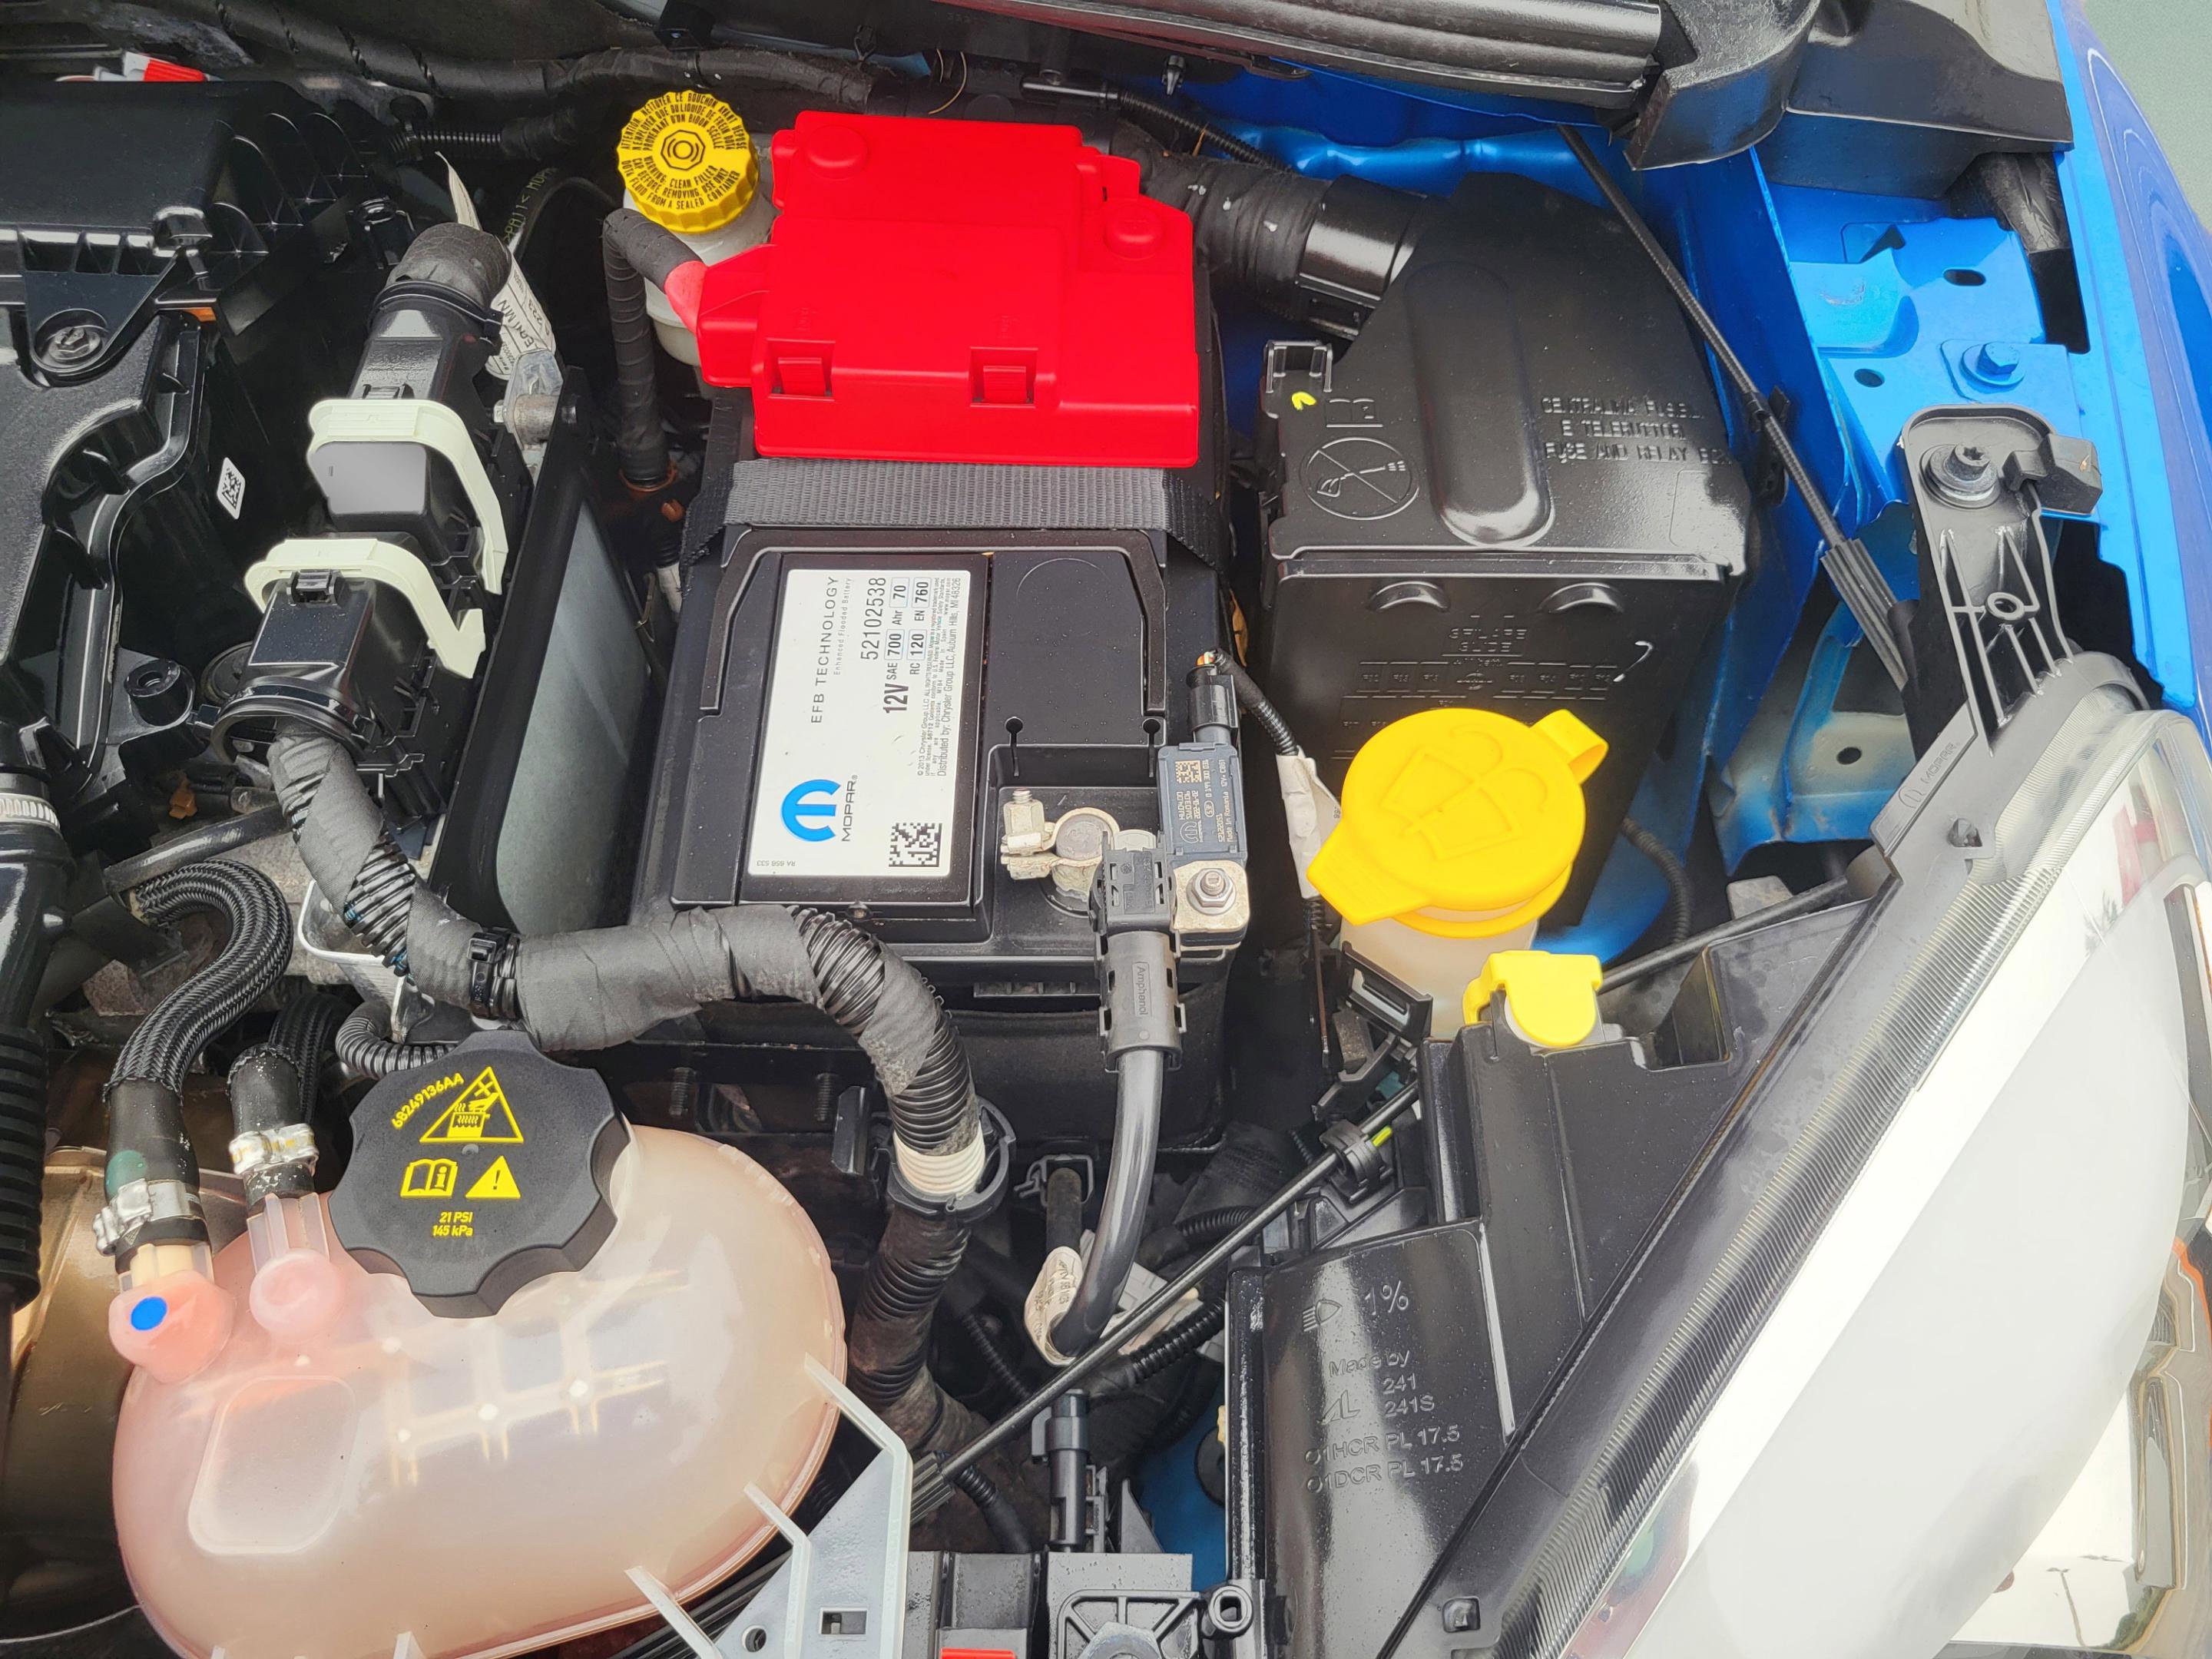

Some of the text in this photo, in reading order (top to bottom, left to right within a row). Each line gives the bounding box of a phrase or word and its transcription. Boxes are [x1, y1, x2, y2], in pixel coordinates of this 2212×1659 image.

[688, 114, 709, 127] BIDON
[632, 157, 644, 169] CAP
[637, 170, 662, 193] BEFORE
[670, 178, 692, 189] CLEAN
[694, 165, 718, 185] FILLER
[701, 180, 716, 193] USE
[713, 167, 729, 184] ONLY
[629, 177, 648, 196] FLUID
[646, 192, 667, 207] FROM
[668, 200, 673, 208] A
[676, 197, 704, 210] SEALED
[707, 171, 740, 202] CONTAINER
[950, 578, 961, 598] 48326
[859, 577, 886, 660] 52102538
[909, 581, 929, 674] RC 120 EN 760
[886, 584, 906, 680] SAE 700 Ahr 70
[945, 628, 957, 652] Auburn
[810, 576, 839, 723] EFB TECHNOLOGY
[942, 671, 955, 691] Group
[882, 683, 909, 714] 12V
[940, 694, 954, 722] Chrysler
[921, 710, 929, 728] Group
[919, 729, 928, 753] Chrysler
[936, 747, 949, 776] Distributed
[1136, 965, 1149, 1015] Amphenol
[391, 1072, 465, 1129] 68249136AA
[439, 1211, 474, 1223] 21 PSI
[432, 1224, 474, 1237] 145 kPa
[1329, 1349, 1410, 1377] Made by
[1383, 1373, 1416, 1395] 241
[1384, 1393, 1435, 1418] 241S
[1385, 1430, 1413, 1450] PL
[1417, 1424, 1460, 1446] 17.5
[1387, 1459, 1416, 1479] PL
[1420, 1453, 1464, 1475] 17.5
